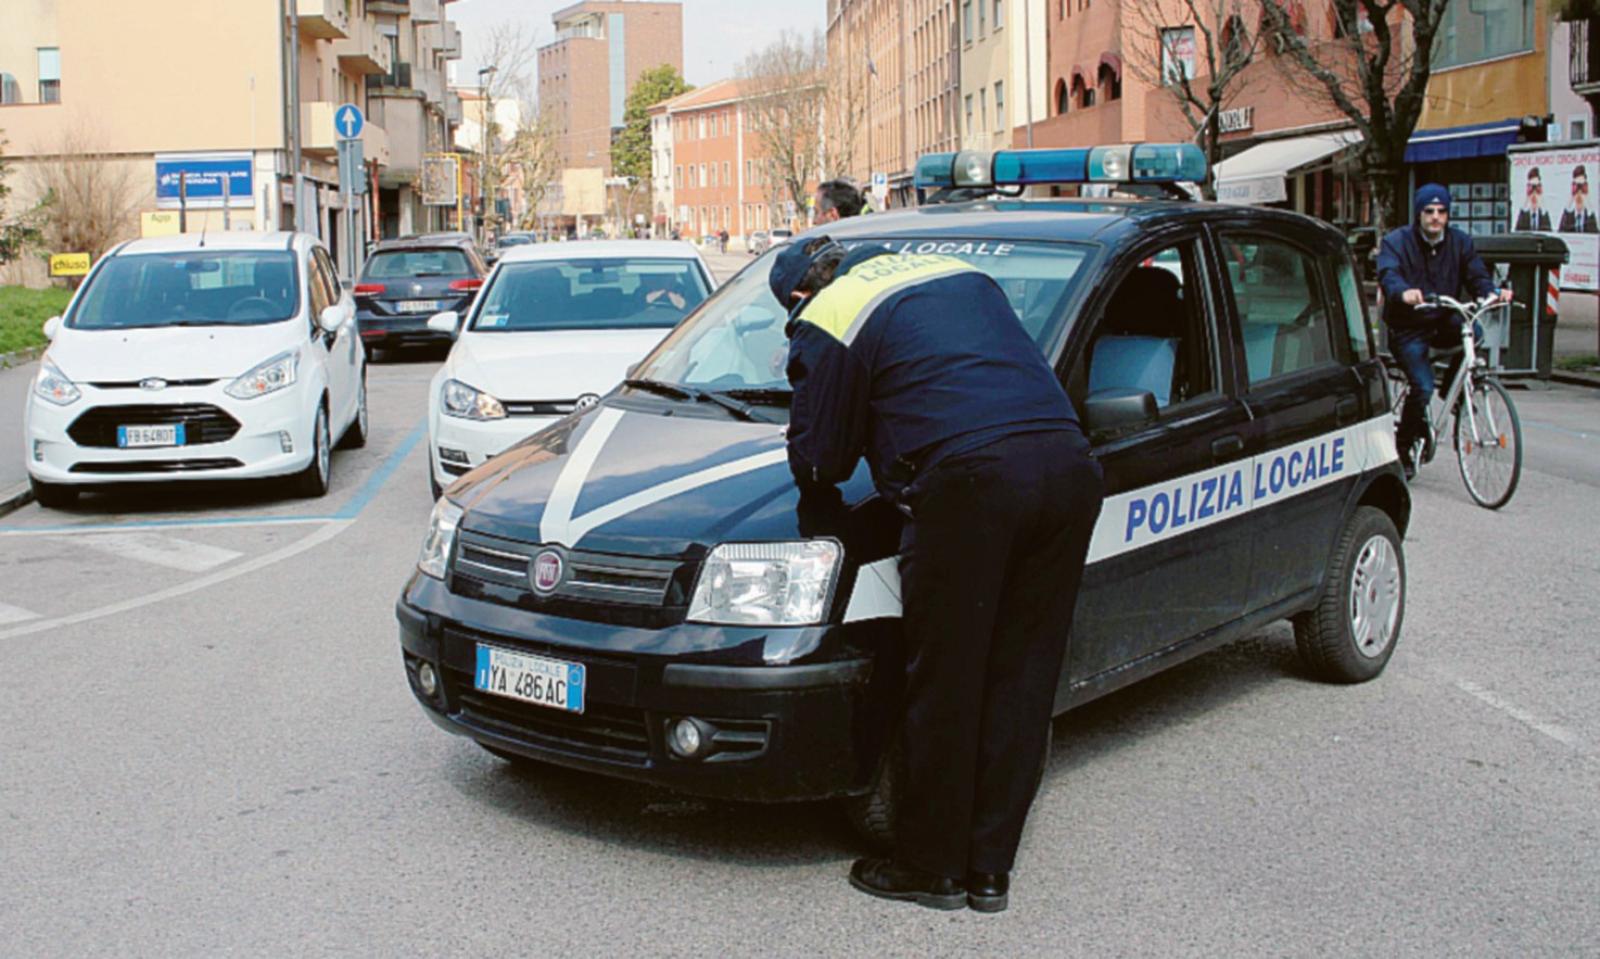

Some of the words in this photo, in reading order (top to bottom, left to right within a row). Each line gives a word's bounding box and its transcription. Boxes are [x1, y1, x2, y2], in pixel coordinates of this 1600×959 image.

[899, 242, 1015, 256] LOCALE
[53, 259, 88, 271] chiuso
[1125, 470, 1243, 543] POLIZIA
[1254, 437, 1345, 500] LOCALE
[491, 664, 507, 692] YA
